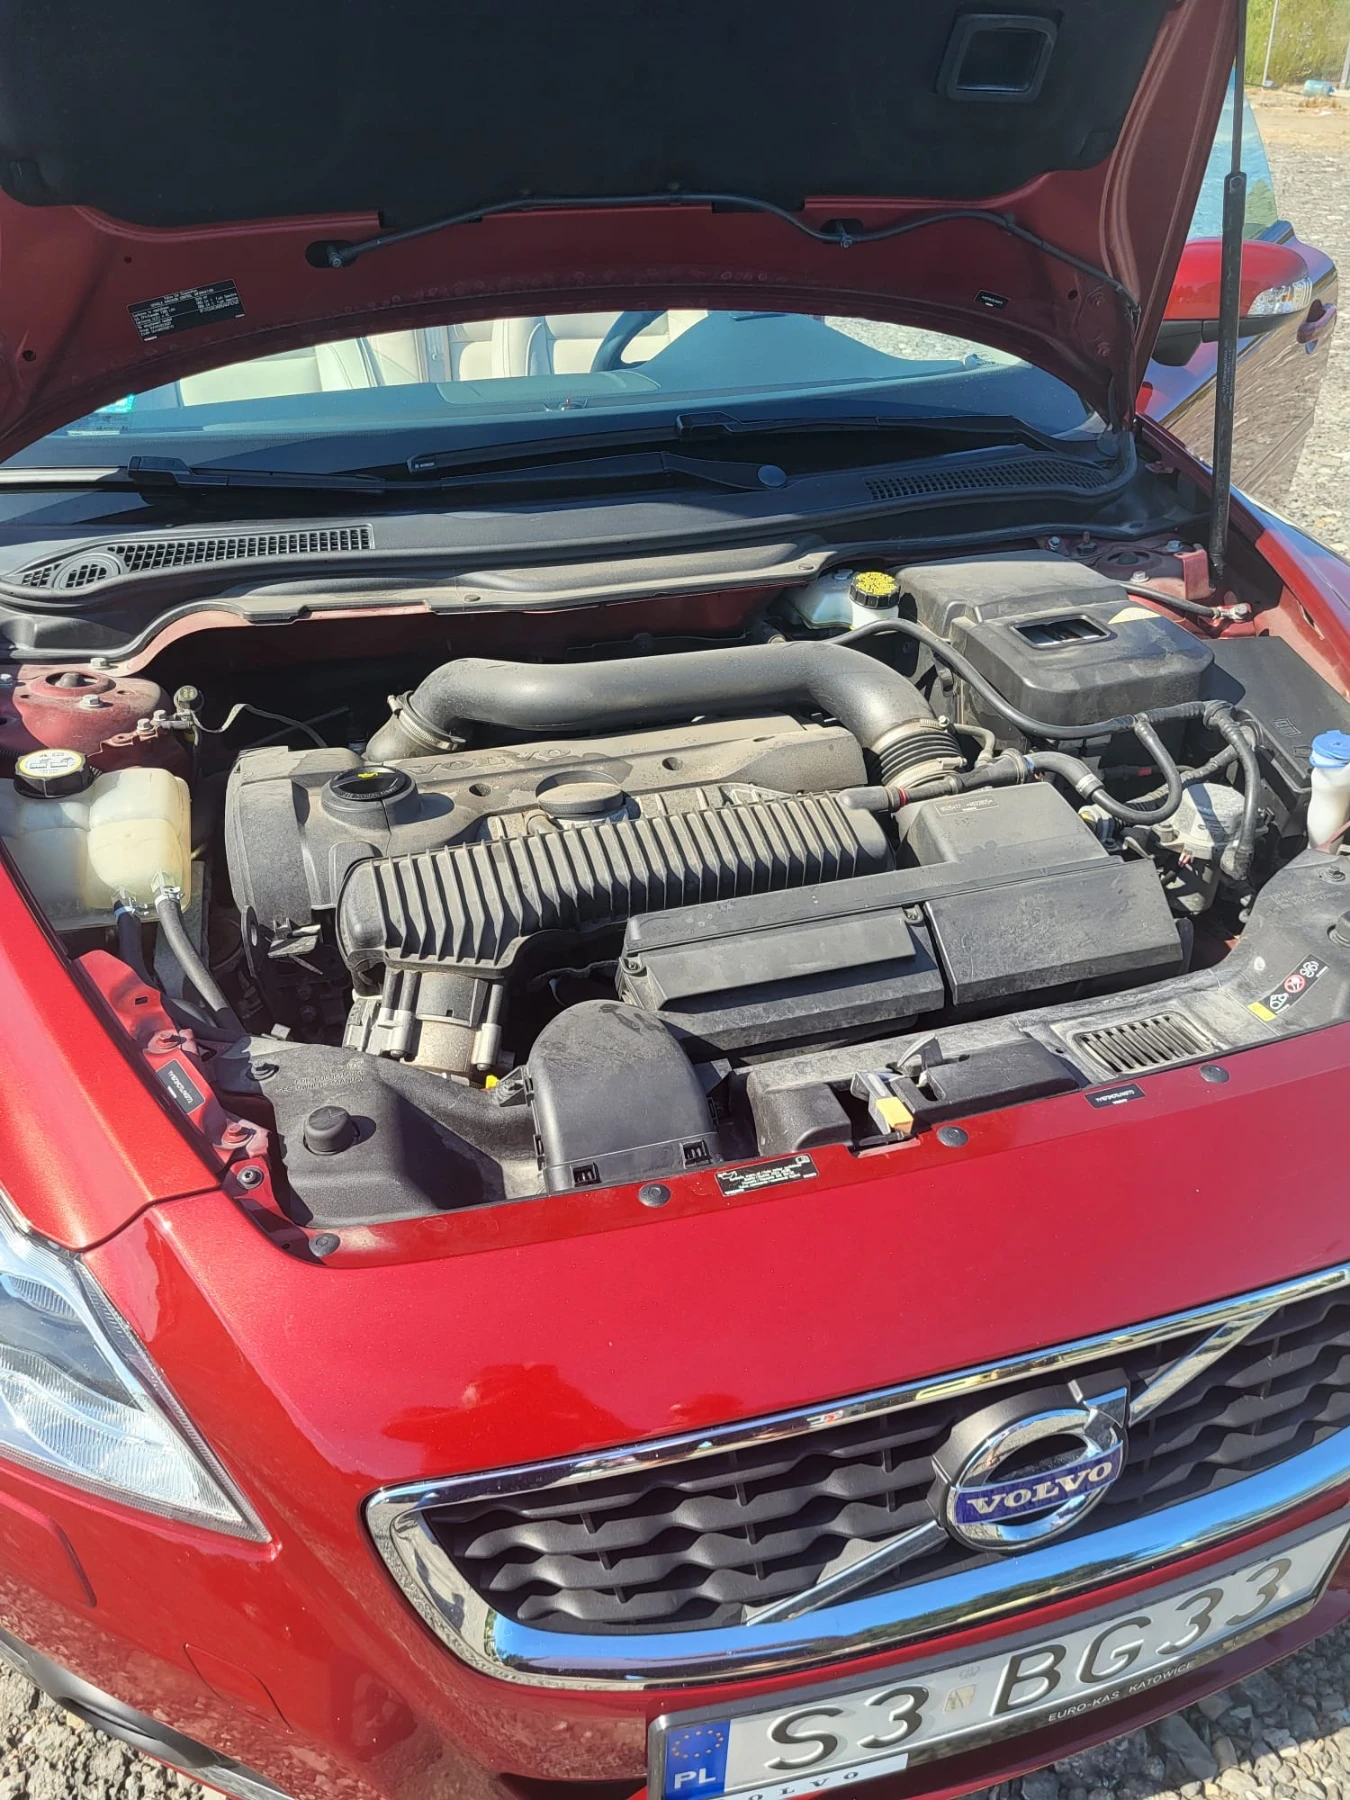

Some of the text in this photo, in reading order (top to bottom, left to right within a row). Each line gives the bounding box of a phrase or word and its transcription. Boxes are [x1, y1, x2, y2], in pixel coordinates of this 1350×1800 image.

[406, 749, 571, 775] VOLVO
[966, 1461, 1113, 1515] VOLVO
[764, 1557, 1293, 1771] S3 BG33
[1048, 1660, 1196, 1722] EURO-KAS KATOWICE
[673, 1767, 717, 1790] PL
[717, 1771, 860, 1800] OLVO
